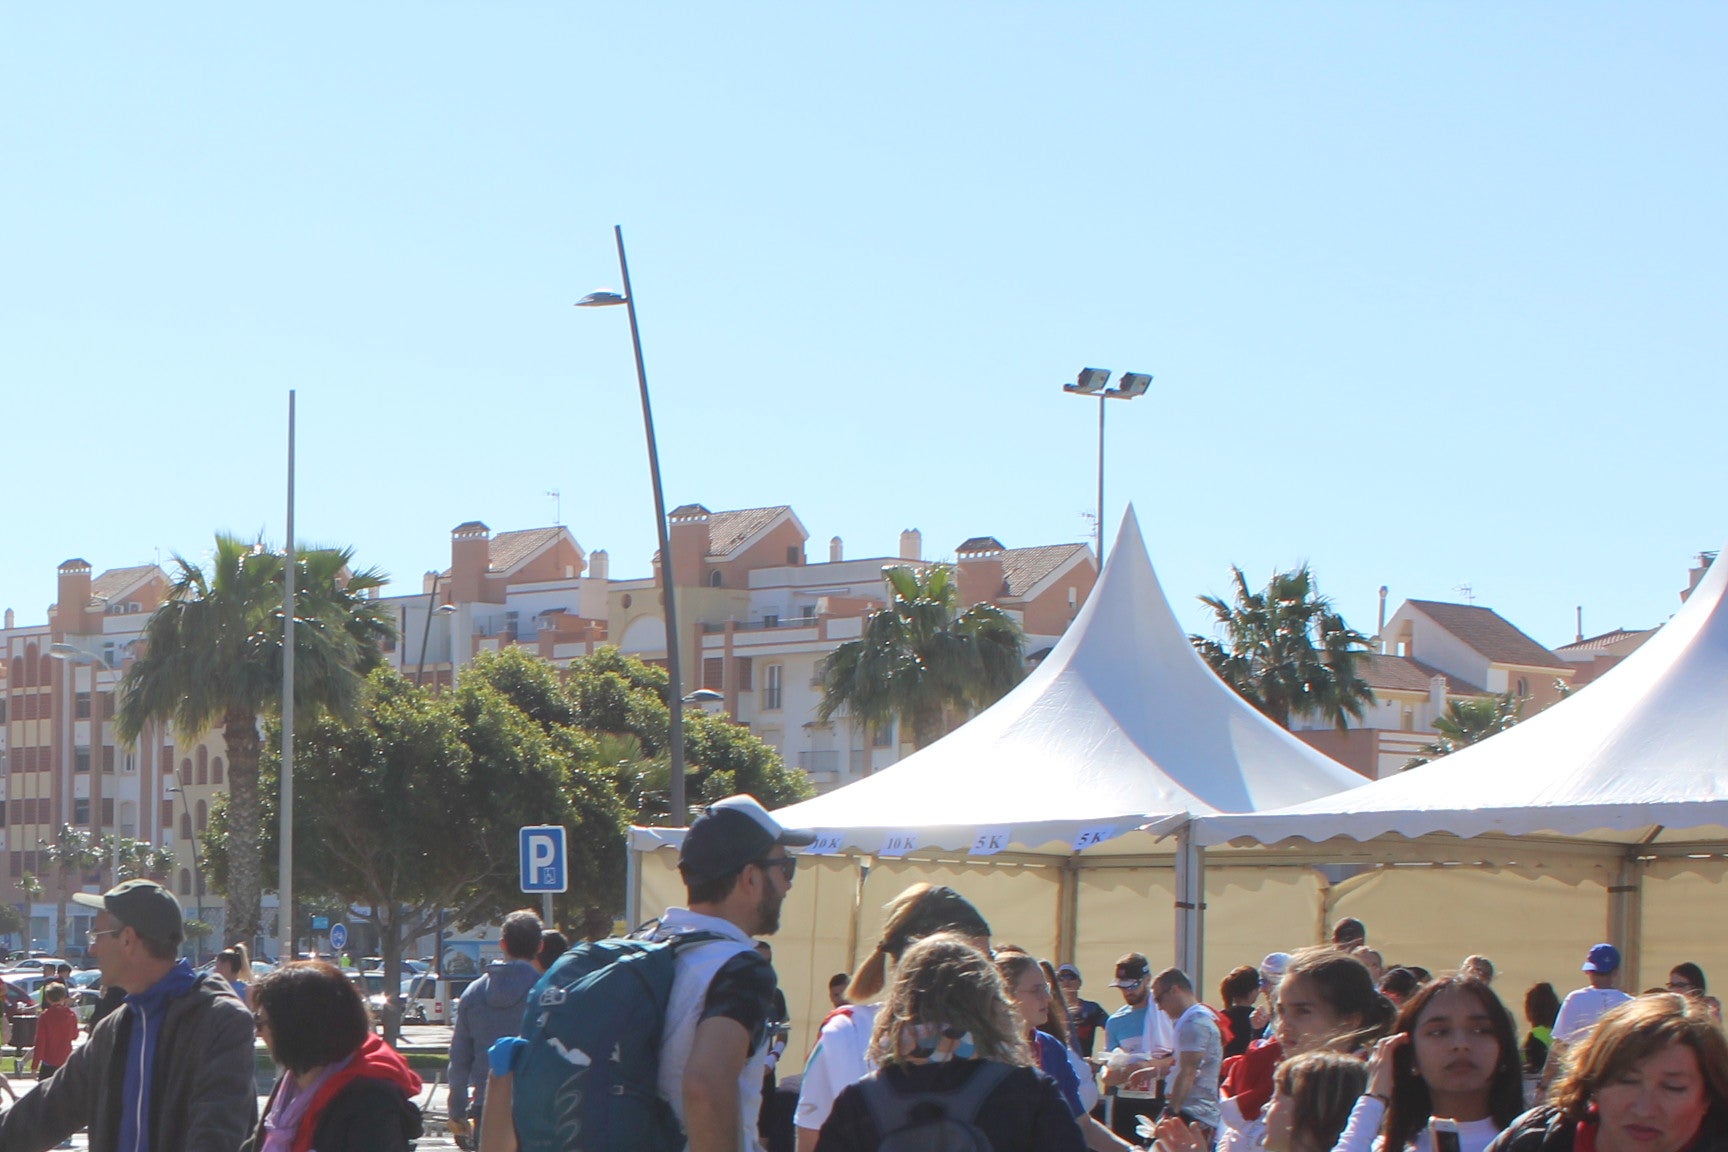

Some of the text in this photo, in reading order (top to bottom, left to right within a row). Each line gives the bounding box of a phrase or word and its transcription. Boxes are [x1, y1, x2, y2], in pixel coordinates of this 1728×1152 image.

[813, 838, 841, 849] 10 K
[886, 836, 916, 850] 10 K
[975, 835, 1003, 849] 5 K
[1077, 831, 1105, 846] 5 K
[529, 835, 555, 884] P
